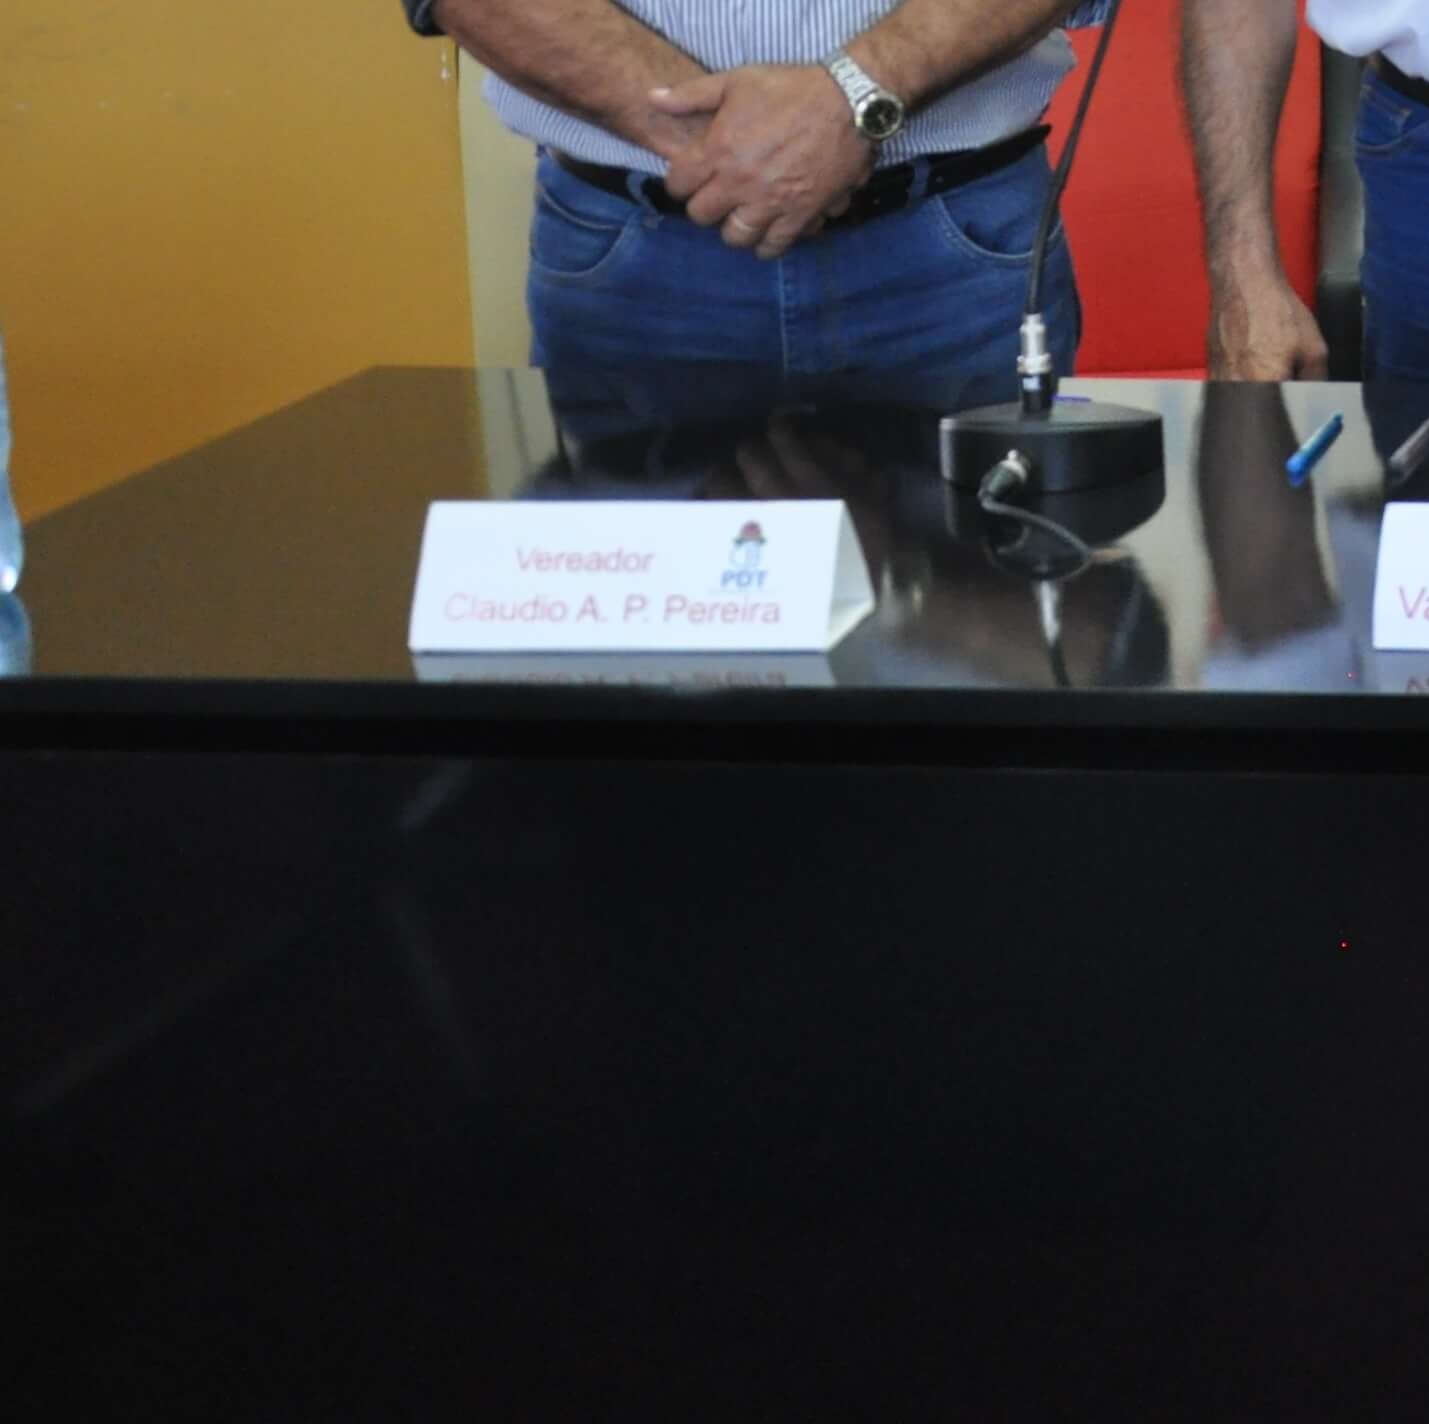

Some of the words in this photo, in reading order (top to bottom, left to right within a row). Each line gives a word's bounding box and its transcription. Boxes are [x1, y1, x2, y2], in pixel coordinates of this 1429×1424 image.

[514, 545, 654, 573] Vereador
[718, 569, 768, 590] PDT
[444, 592, 568, 624] Claudio
[574, 595, 608, 624] A.
[621, 595, 650, 624] P.
[663, 595, 782, 624] Pereira
